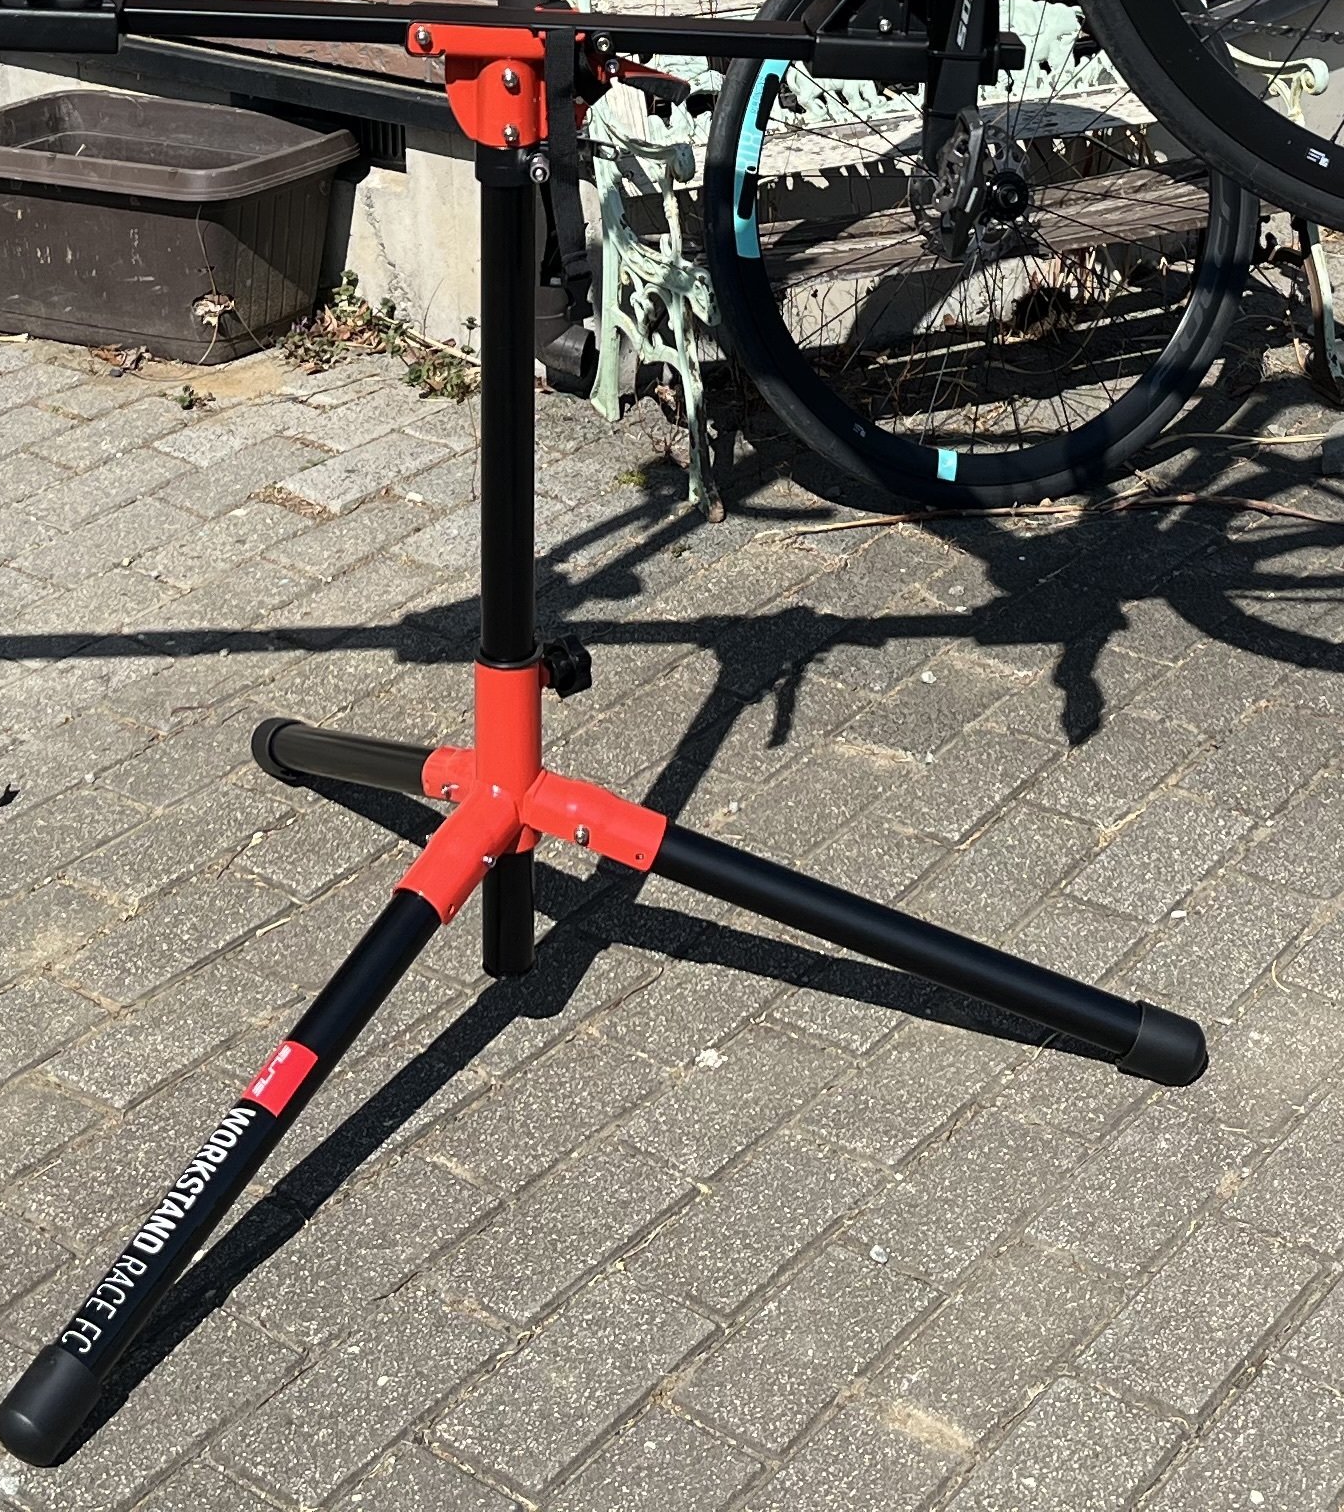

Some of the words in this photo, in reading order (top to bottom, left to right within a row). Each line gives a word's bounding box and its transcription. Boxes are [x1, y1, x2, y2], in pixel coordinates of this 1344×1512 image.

[132, 1106, 257, 1255] WORKSTAND
[85, 1254, 148, 1320] RACE
[61, 1317, 103, 1354] FC
